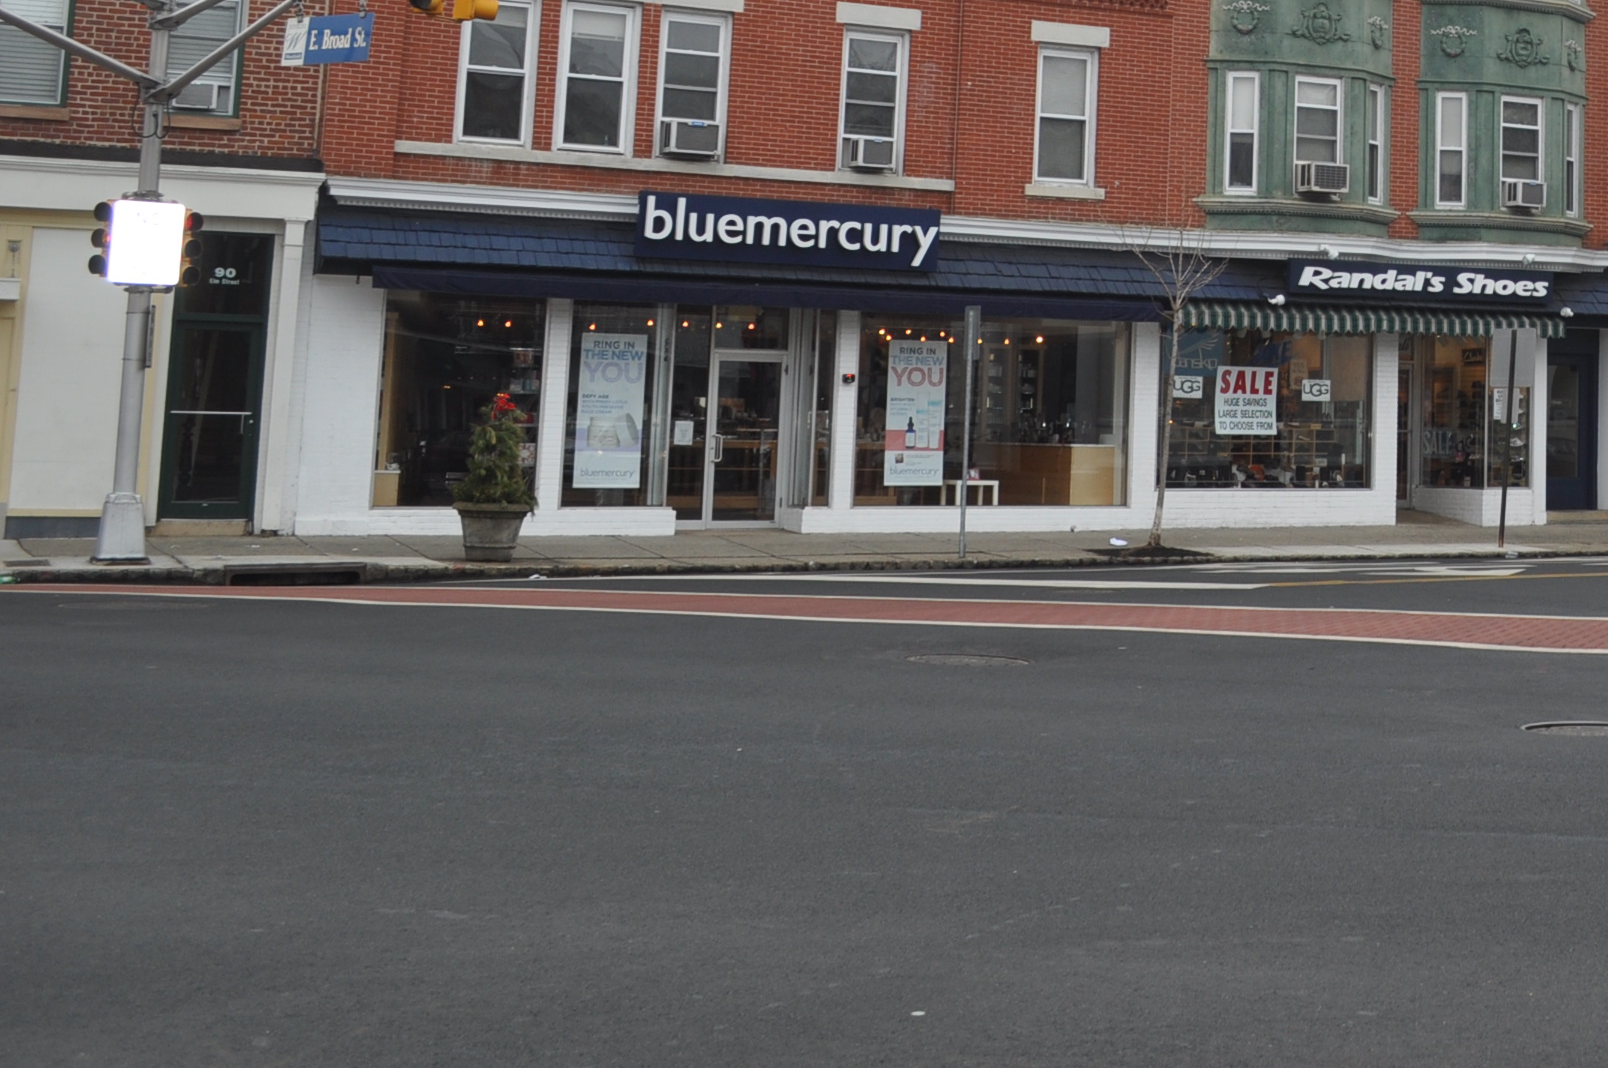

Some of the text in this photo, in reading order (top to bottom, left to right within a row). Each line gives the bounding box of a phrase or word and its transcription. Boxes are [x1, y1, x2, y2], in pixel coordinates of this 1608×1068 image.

[321, 27, 353, 50] Broad
[353, 26, 367, 47] St.
[644, 194, 939, 267] bluemercury
[214, 267, 237, 278] 90
[1298, 266, 1549, 297] Randal's Shoes
[593, 340, 636, 350] RING IN
[899, 346, 937, 356] RING IN
[583, 348, 644, 362] THE NEW
[890, 355, 945, 367] THE NEW
[583, 360, 644, 384] YOU
[890, 365, 945, 388] YOU
[1173, 379, 1202, 394] UGG
[1219, 369, 1275, 396] SALE
[1303, 382, 1330, 398] UGG
[1223, 397, 1268, 407] HUGE SAVINGS
[1218, 409, 1273, 420] LARGE SELECTION
[1219, 421, 1274, 431] TO CHOOSE FROM
[580, 467, 635, 479] bluemercury
